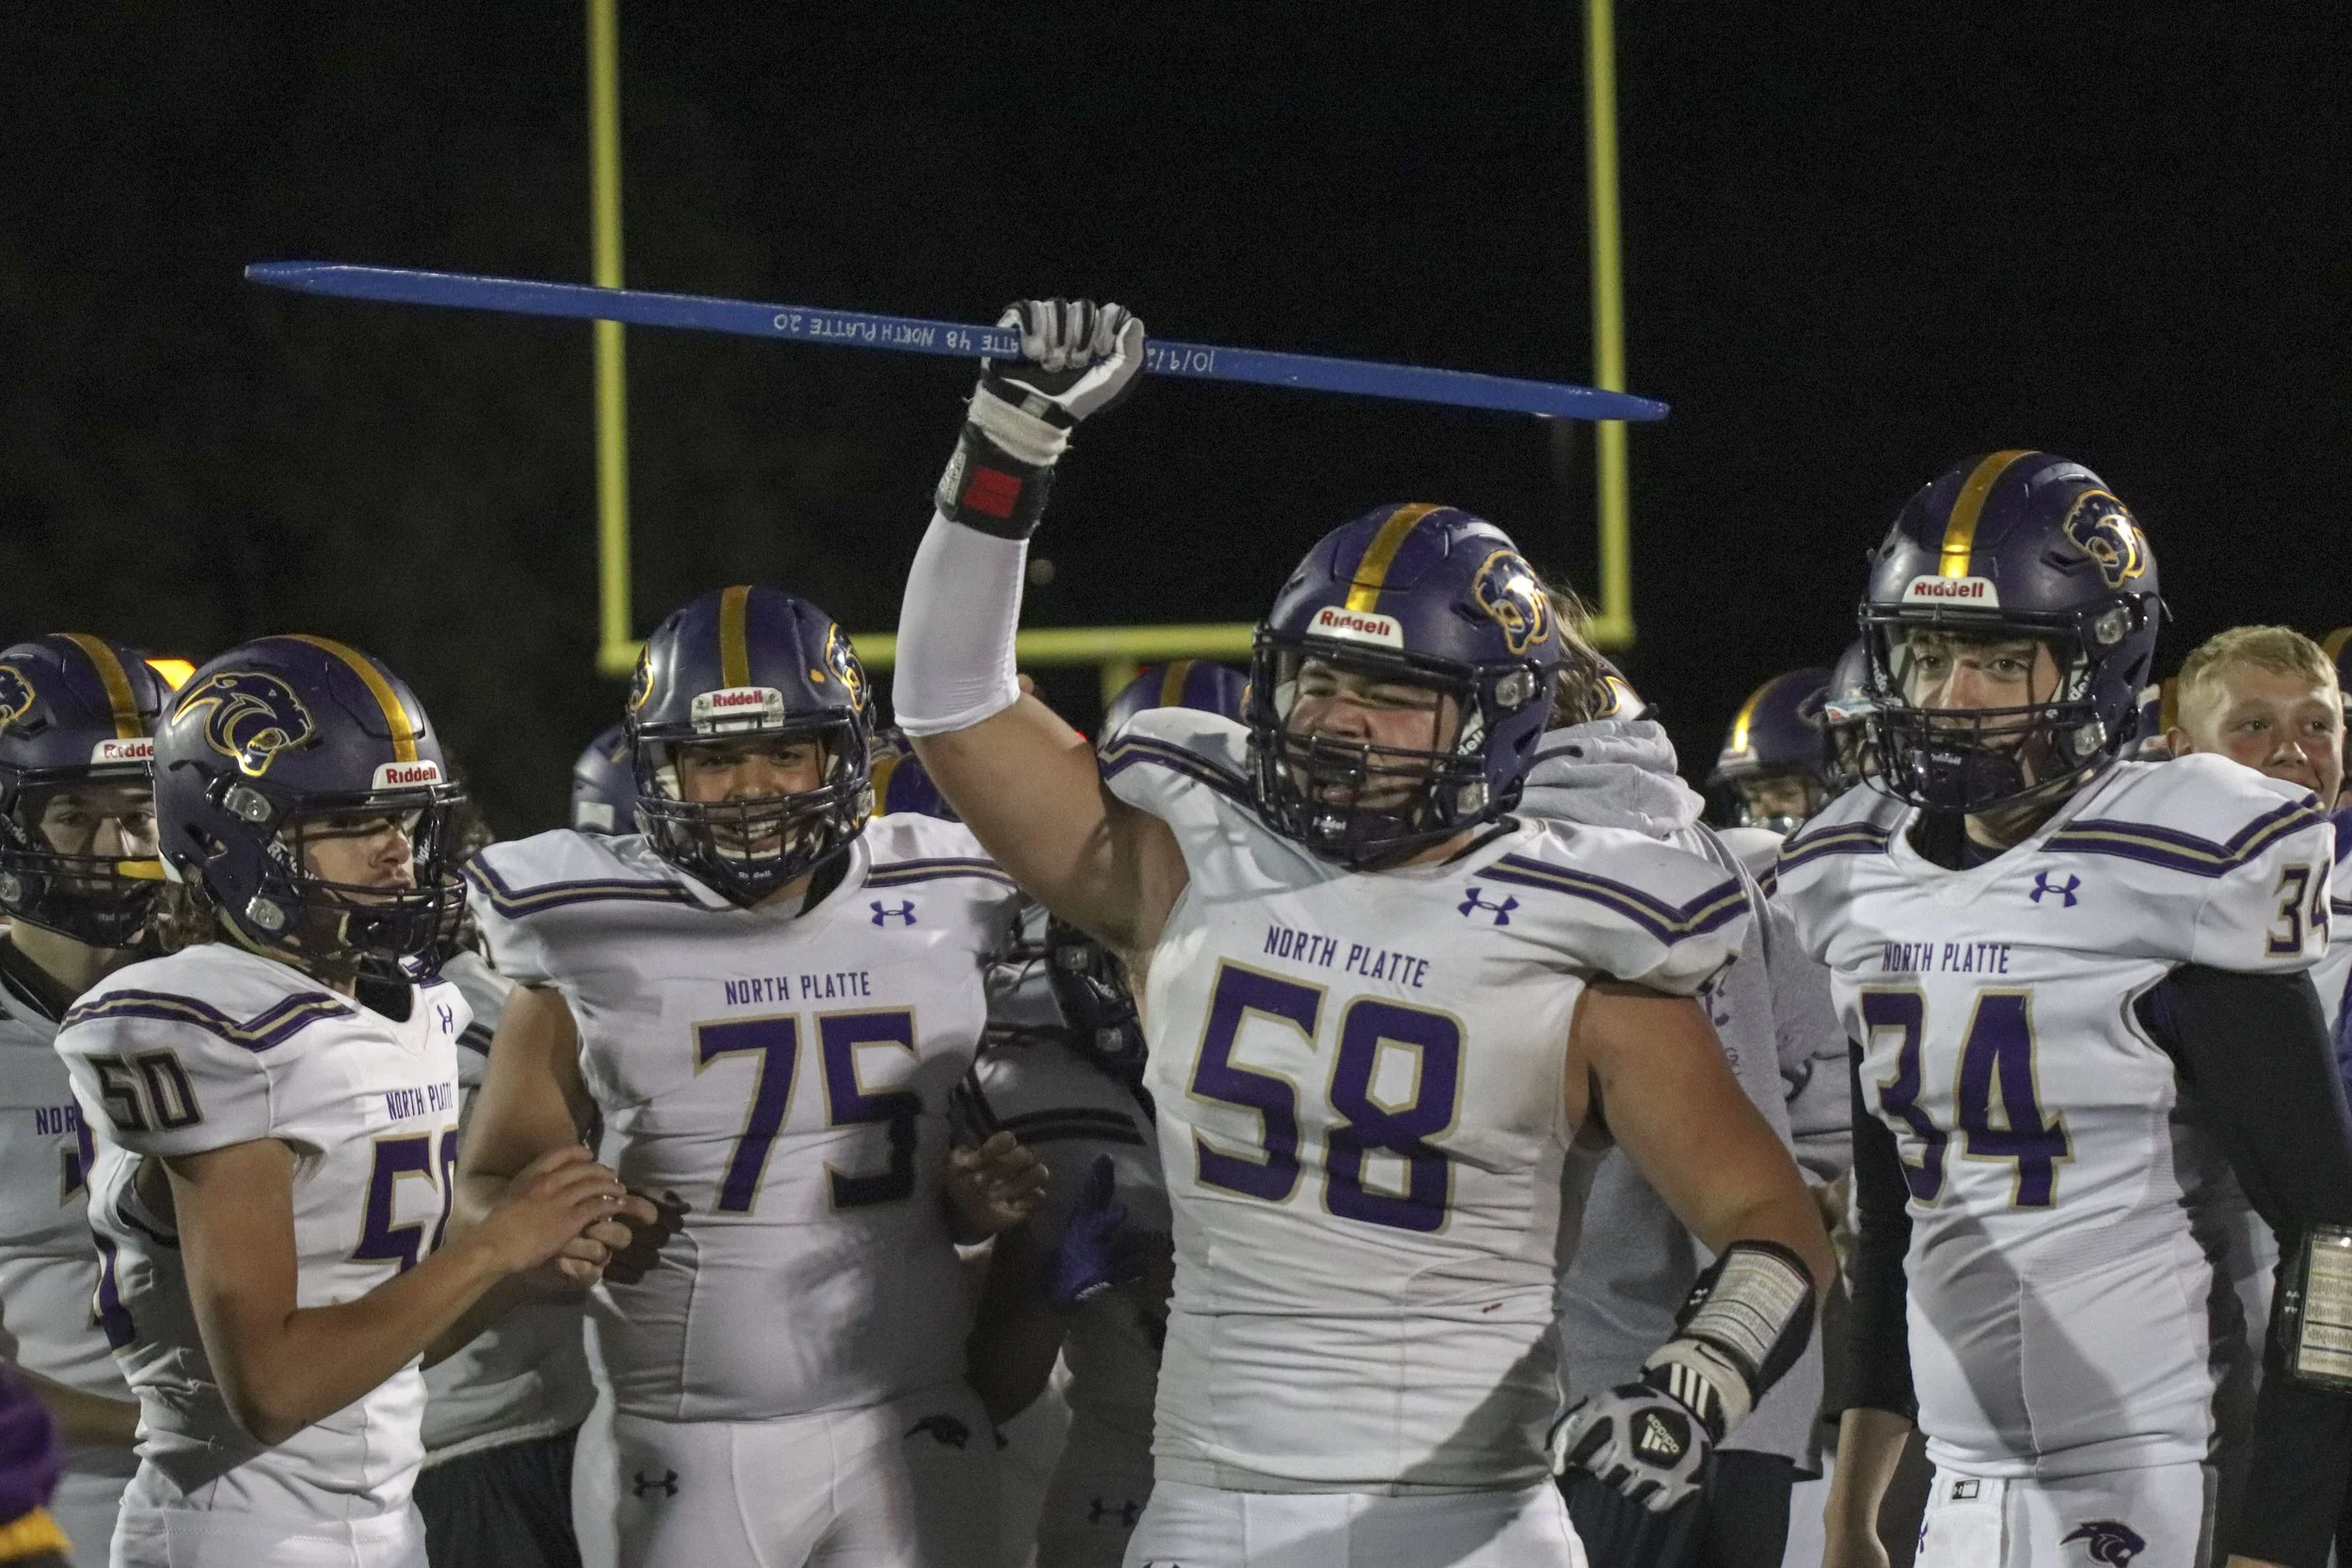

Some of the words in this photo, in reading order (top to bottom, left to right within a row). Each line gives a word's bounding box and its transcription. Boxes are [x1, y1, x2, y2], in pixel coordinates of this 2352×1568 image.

[773, 312, 803, 332] 20
[809, 317, 876, 341] PLATTE
[882, 325, 935, 347] NORTH
[946, 330, 971, 351] 48
[981, 334, 1019, 354] ATTE
[1914, 581, 1984, 597] Riddell
[1319, 610, 1391, 636] Riddell
[712, 689, 763, 707] Riddell
[103, 743, 154, 758] Ridde
[386, 766, 437, 784] Riddell
[2265, 857, 2330, 958] 34
[1263, 925, 1338, 967] NORTH
[1345, 943, 1431, 988] PLATTE
[1882, 942, 1933, 973] NORTH
[1942, 942, 2012, 974] PLATTE
[725, 976, 789, 1005] NORTH
[801, 972, 871, 999] PLATTE
[83, 1047, 204, 1132] 50
[386, 1087, 424, 1120] NORTH
[1185, 956, 1468, 1236] 58
[1860, 985, 2076, 1211] 34
[35, 1105, 77, 1135] NOR
[691, 1005, 923, 1216] 75
[1646, 1413, 1679, 1453] adidas
